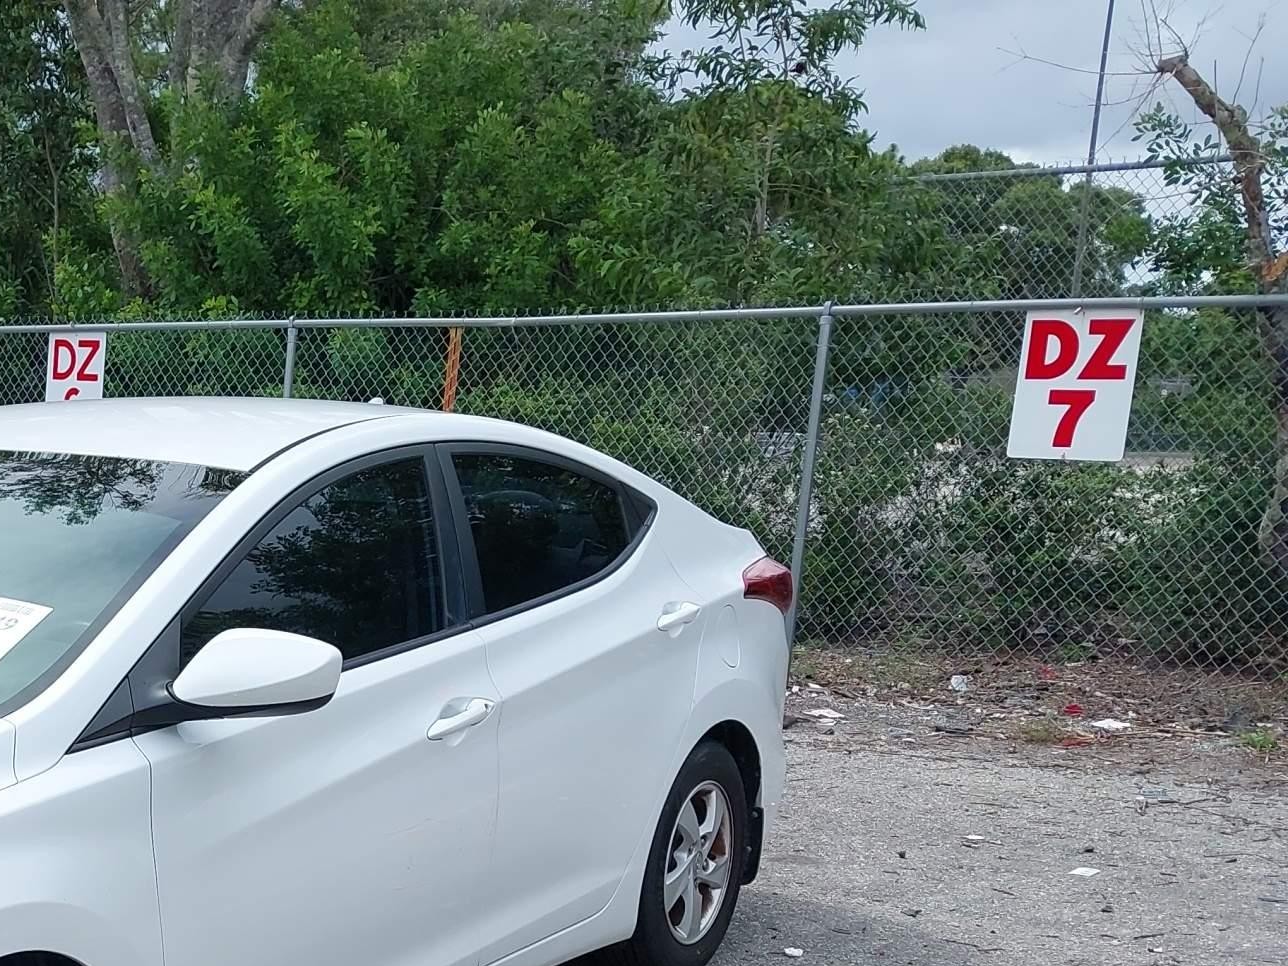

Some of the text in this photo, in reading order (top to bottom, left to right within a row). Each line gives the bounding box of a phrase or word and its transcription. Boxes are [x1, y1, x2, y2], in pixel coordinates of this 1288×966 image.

[52, 339, 101, 382] DZ
[1024, 318, 1137, 380] DZ
[1047, 389, 1097, 448] 7
